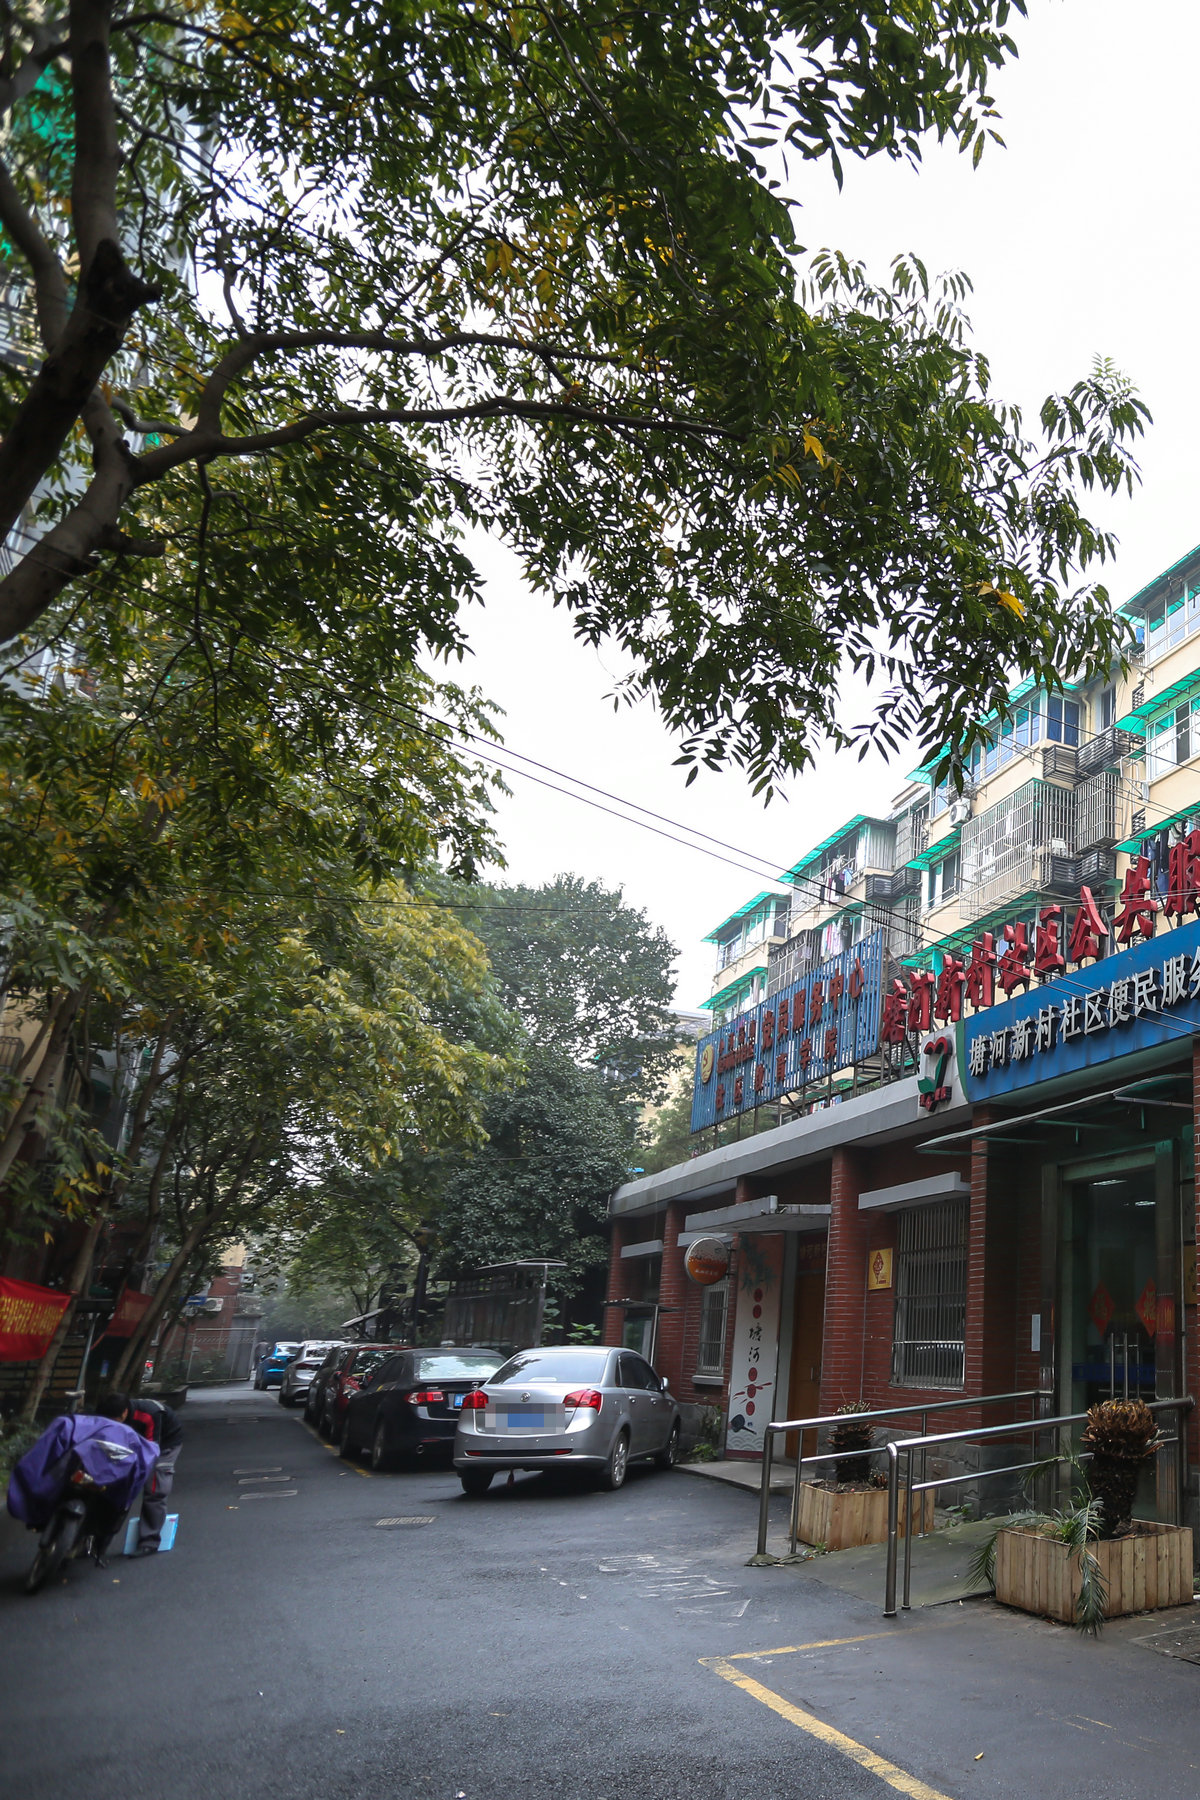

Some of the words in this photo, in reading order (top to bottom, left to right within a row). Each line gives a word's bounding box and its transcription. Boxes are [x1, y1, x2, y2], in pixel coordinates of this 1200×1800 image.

[762, 958, 865, 1051] 党员服务中心
